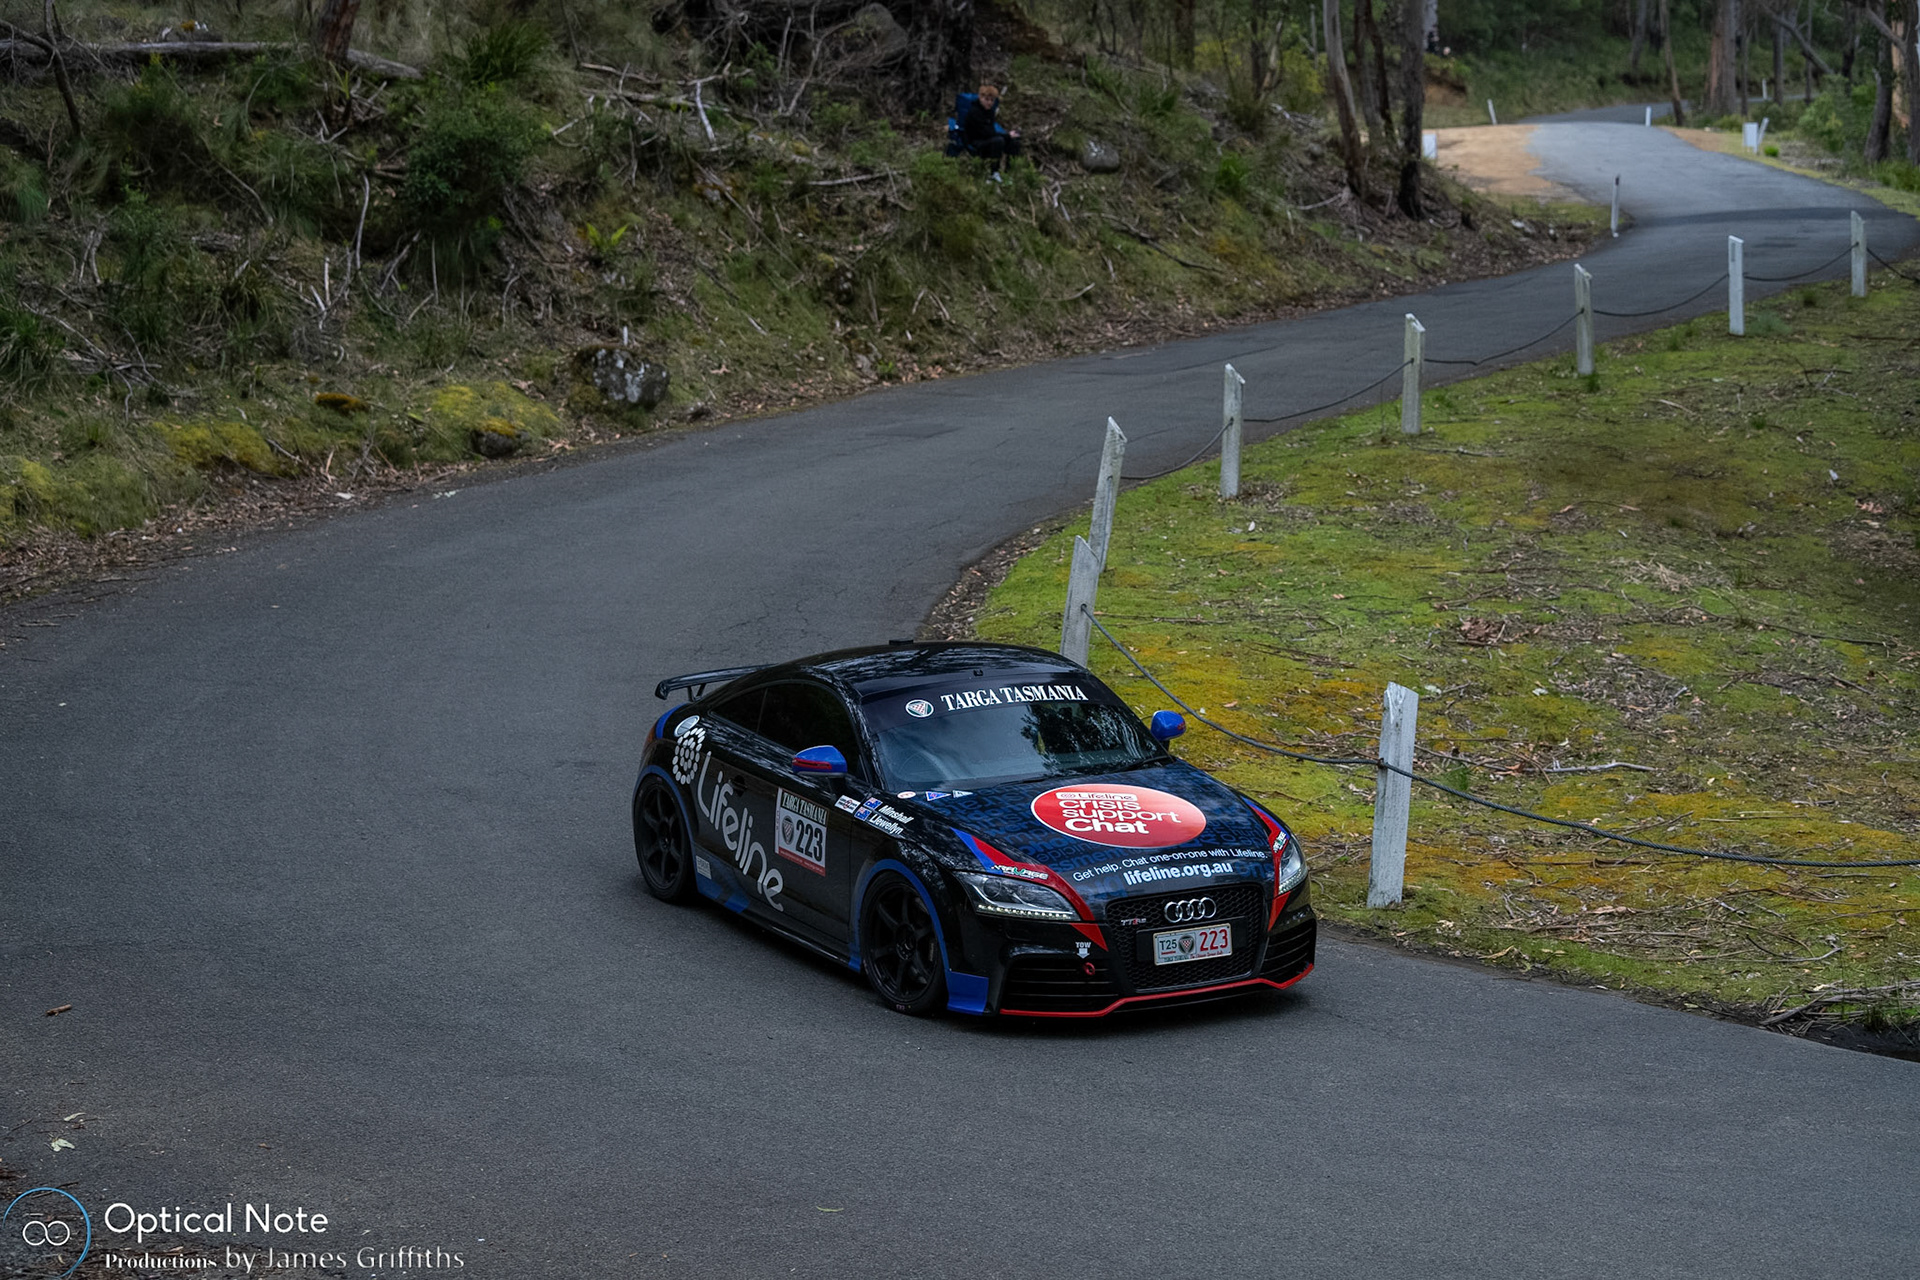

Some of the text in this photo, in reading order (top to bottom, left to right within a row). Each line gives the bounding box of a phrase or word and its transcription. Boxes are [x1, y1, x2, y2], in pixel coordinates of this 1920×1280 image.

[941, 685, 1088, 711] TARGA TASMANIA
[1078, 793, 1133, 801] Lifeline
[1062, 808, 1182, 823] support
[1065, 818, 1149, 834] Chat
[697, 751, 784, 912] Lifeline
[795, 819, 823, 862] 223
[1073, 848, 1268, 882] Get help. Chat one-on-one with Lifeline.
[1123, 862, 1233, 886] lifeline.org.au
[1075, 941, 1092, 949] TOW
[1159, 939, 1177, 951] T25
[1199, 928, 1228, 952] 223
